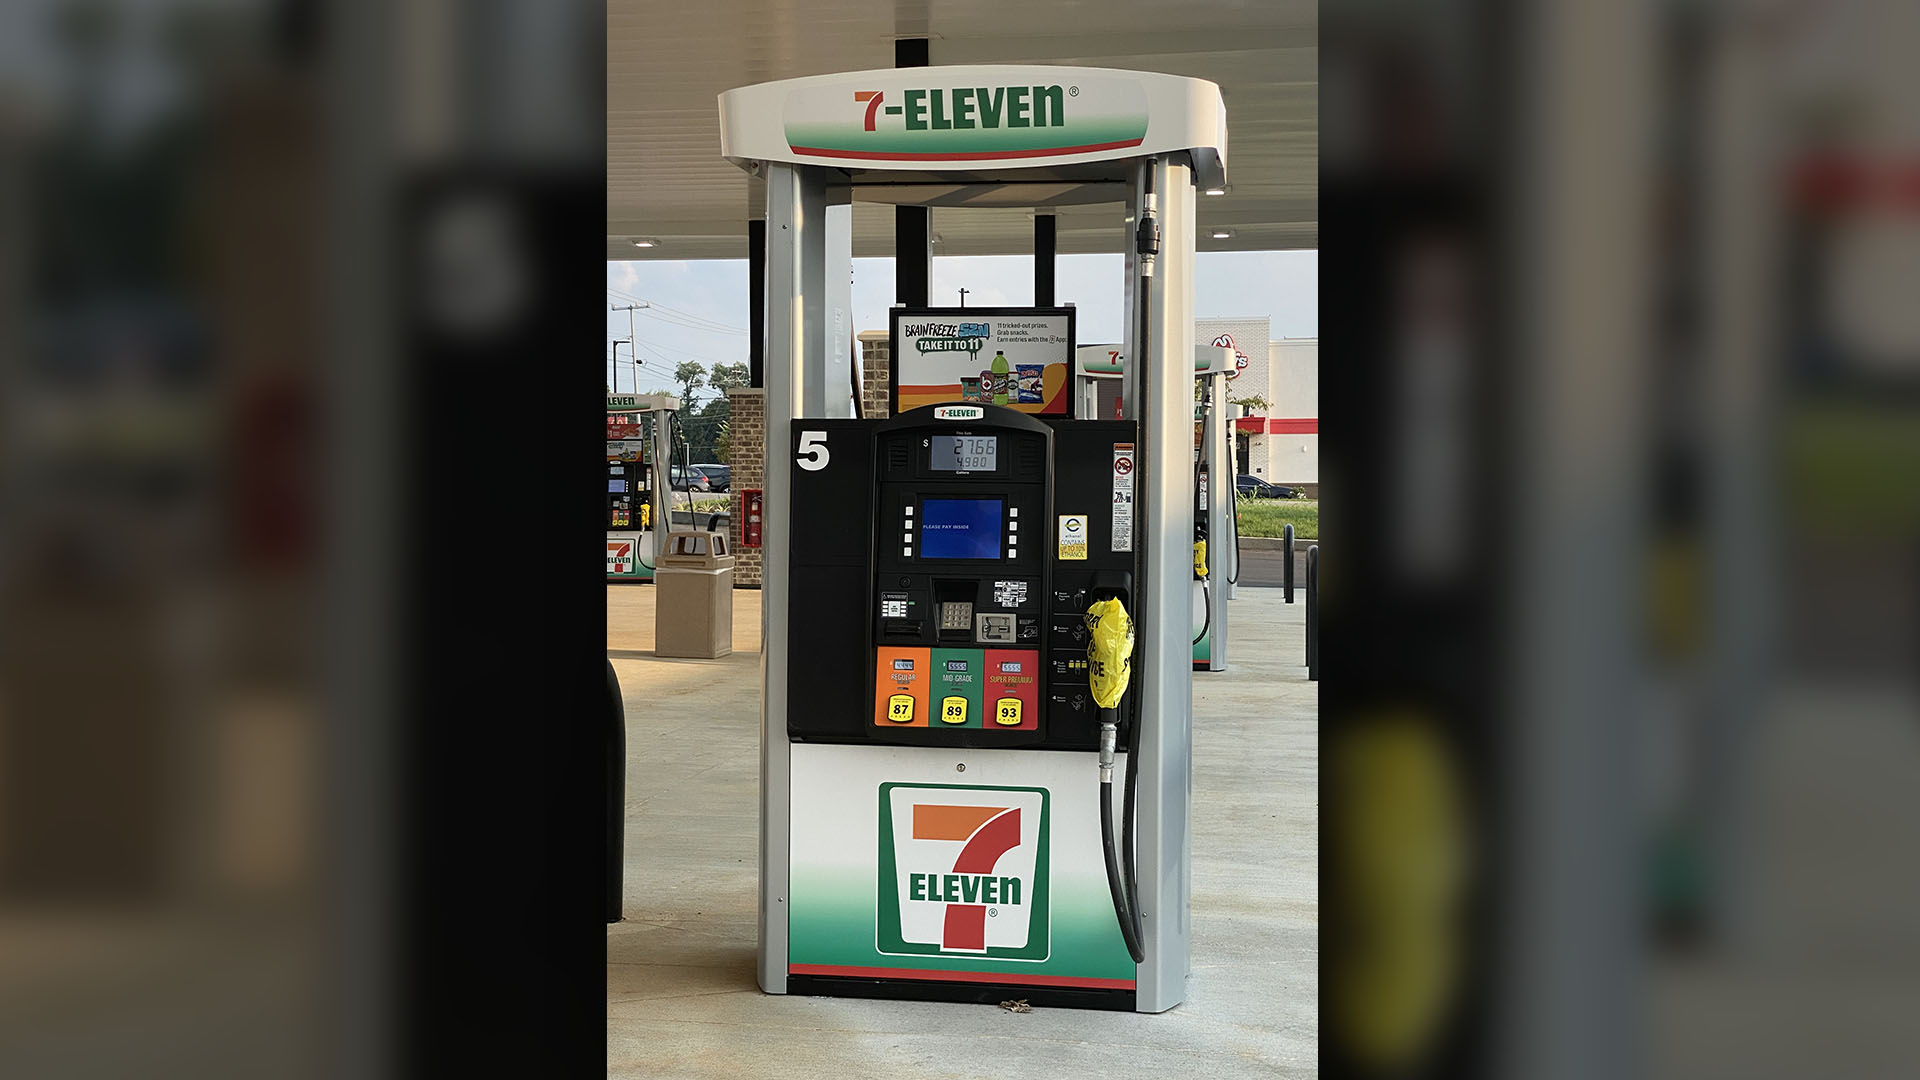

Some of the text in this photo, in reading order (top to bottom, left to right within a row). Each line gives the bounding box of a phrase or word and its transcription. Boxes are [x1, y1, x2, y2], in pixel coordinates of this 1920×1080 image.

[919, 338, 979, 350] TAKE IT TO 11
[923, 439, 929, 447] $
[796, 431, 830, 471] 5
[891, 673, 916, 681] REGULAR
[893, 704, 909, 715] 87
[946, 706, 962, 716] 89
[1001, 708, 1017, 718] 93
[910, 873, 1022, 905] ELEVEn
